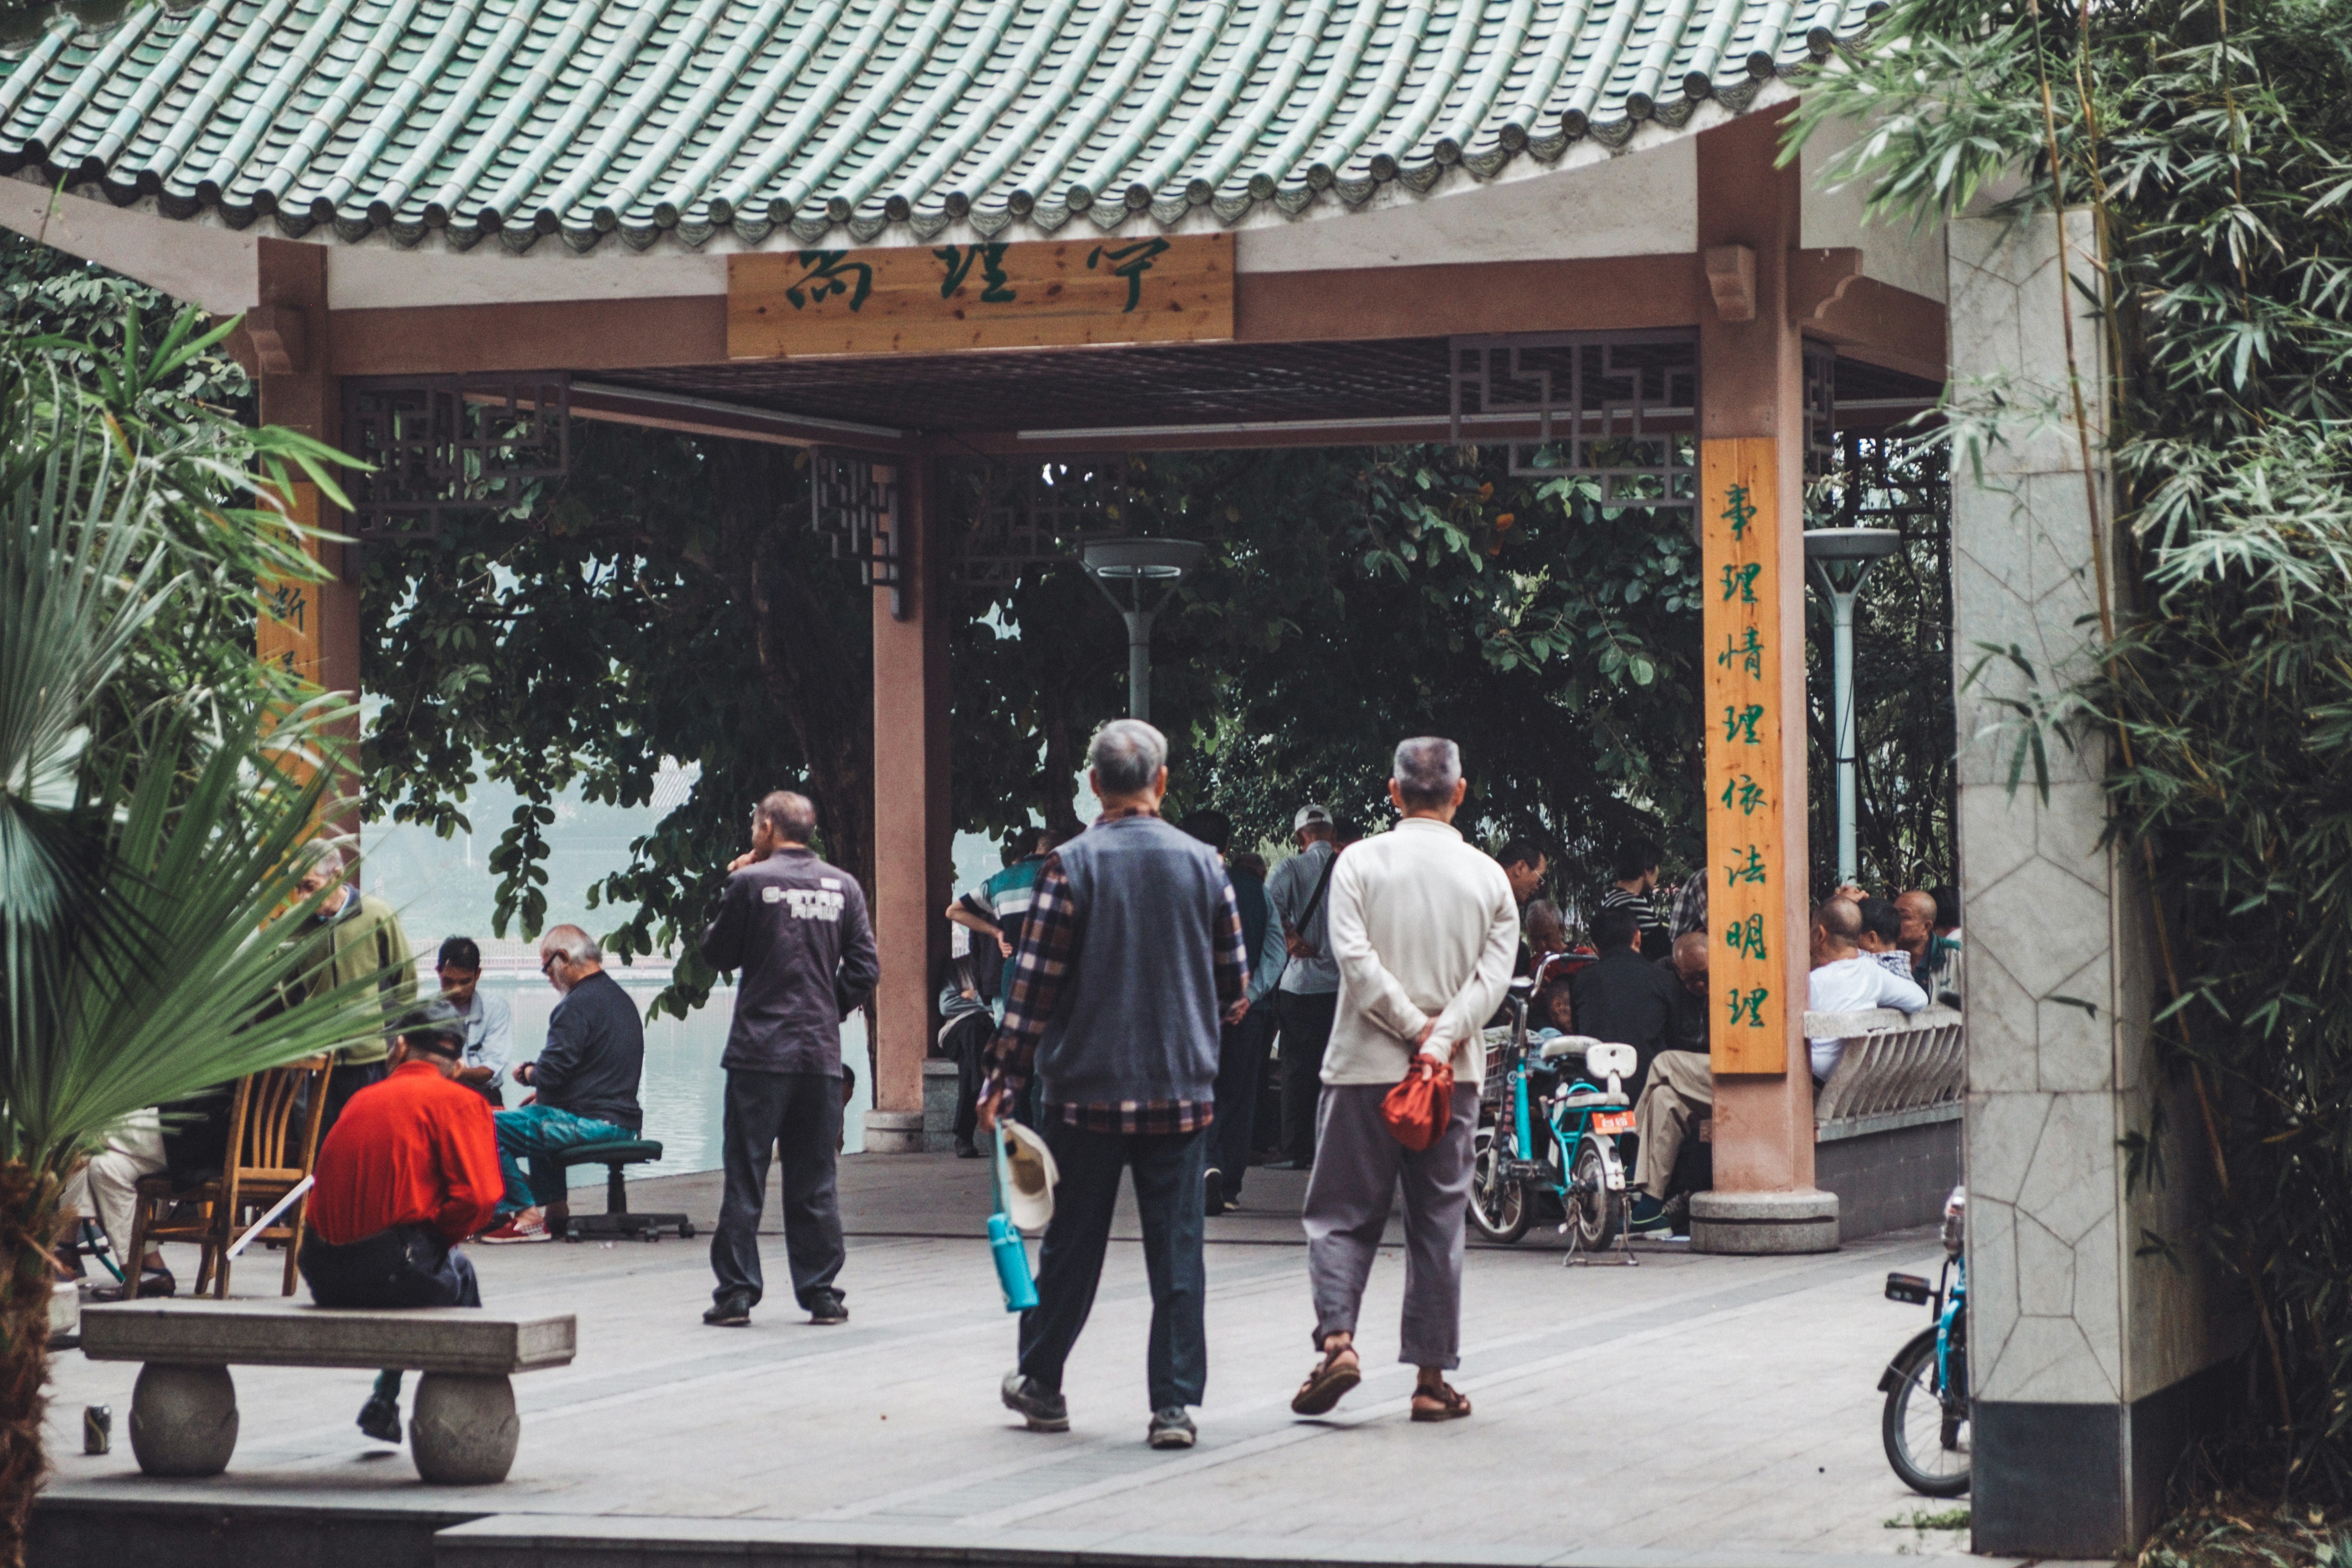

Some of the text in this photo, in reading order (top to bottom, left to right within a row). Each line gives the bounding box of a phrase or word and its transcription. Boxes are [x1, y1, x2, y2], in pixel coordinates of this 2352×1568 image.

[1718, 483, 1768, 1028] 事理情理依法明理
